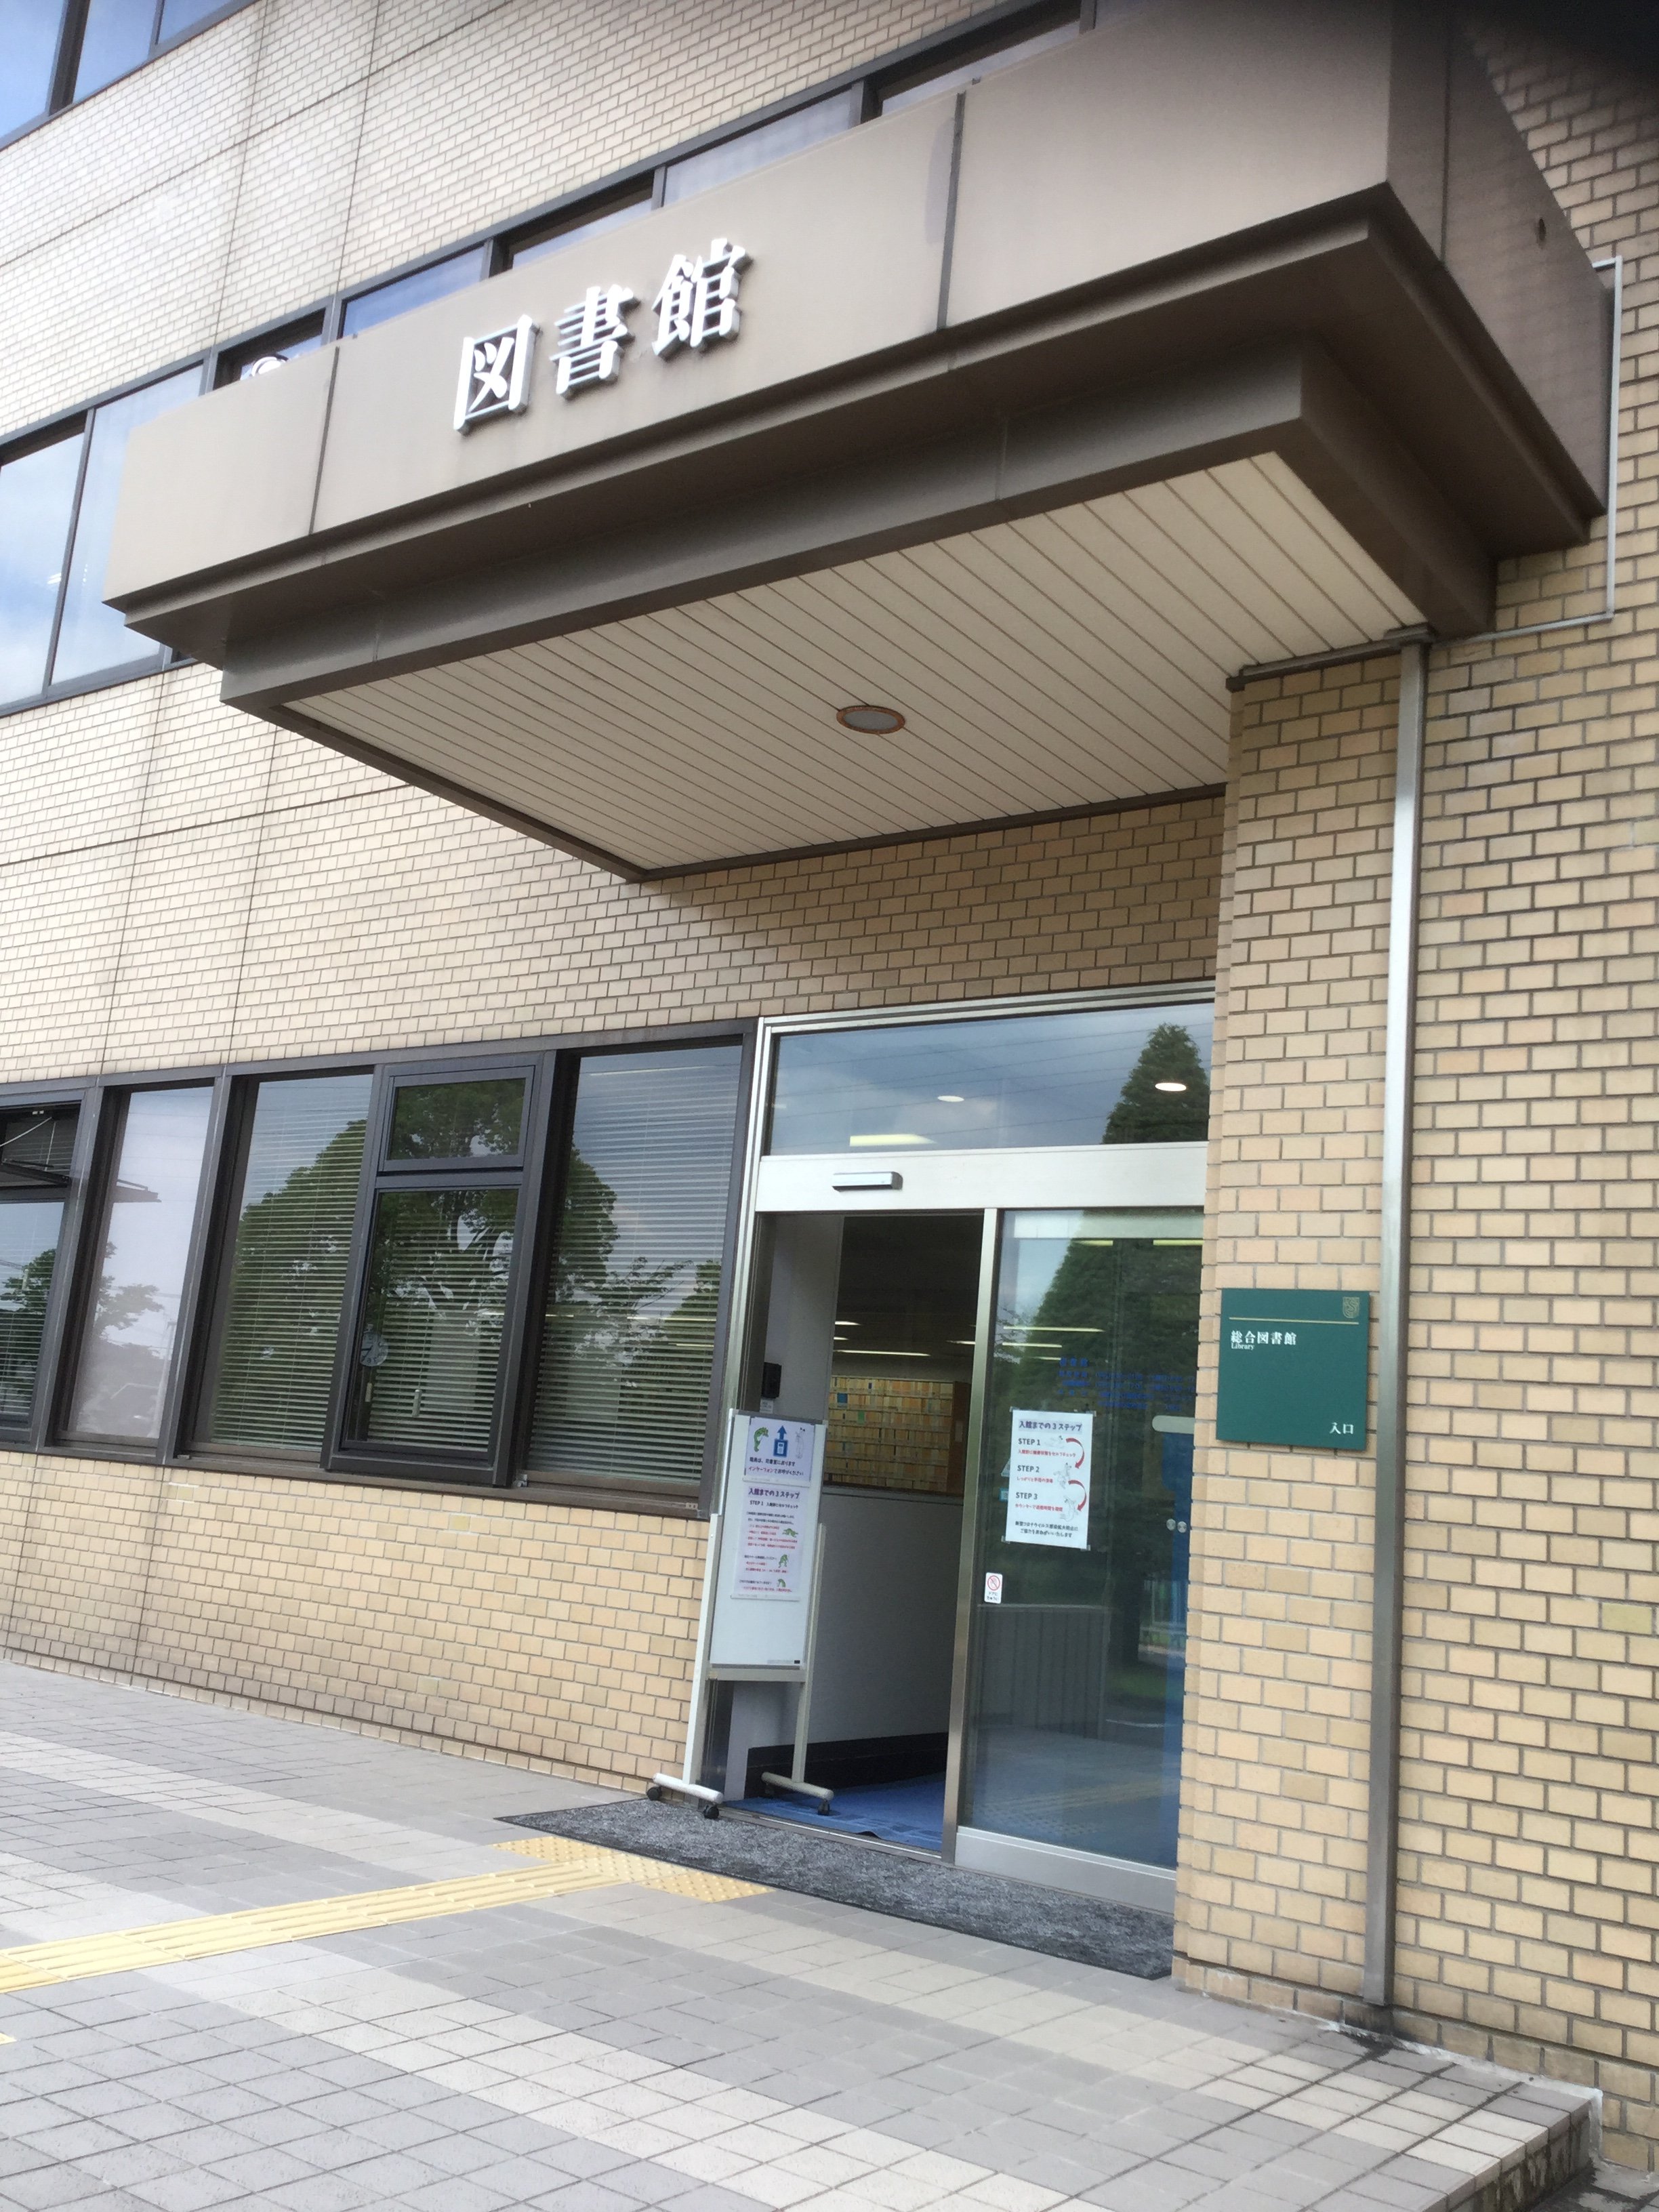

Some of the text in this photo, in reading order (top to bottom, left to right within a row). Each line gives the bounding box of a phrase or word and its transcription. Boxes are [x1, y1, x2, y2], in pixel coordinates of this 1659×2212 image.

[453, 238, 749, 434] 図書館
[1231, 1330, 1296, 1345] 総合図書館
[1231, 1343, 1254, 1351] Library
[1330, 1422, 1354, 1435] 入口
[1016, 1492, 1032, 1500] STEP
